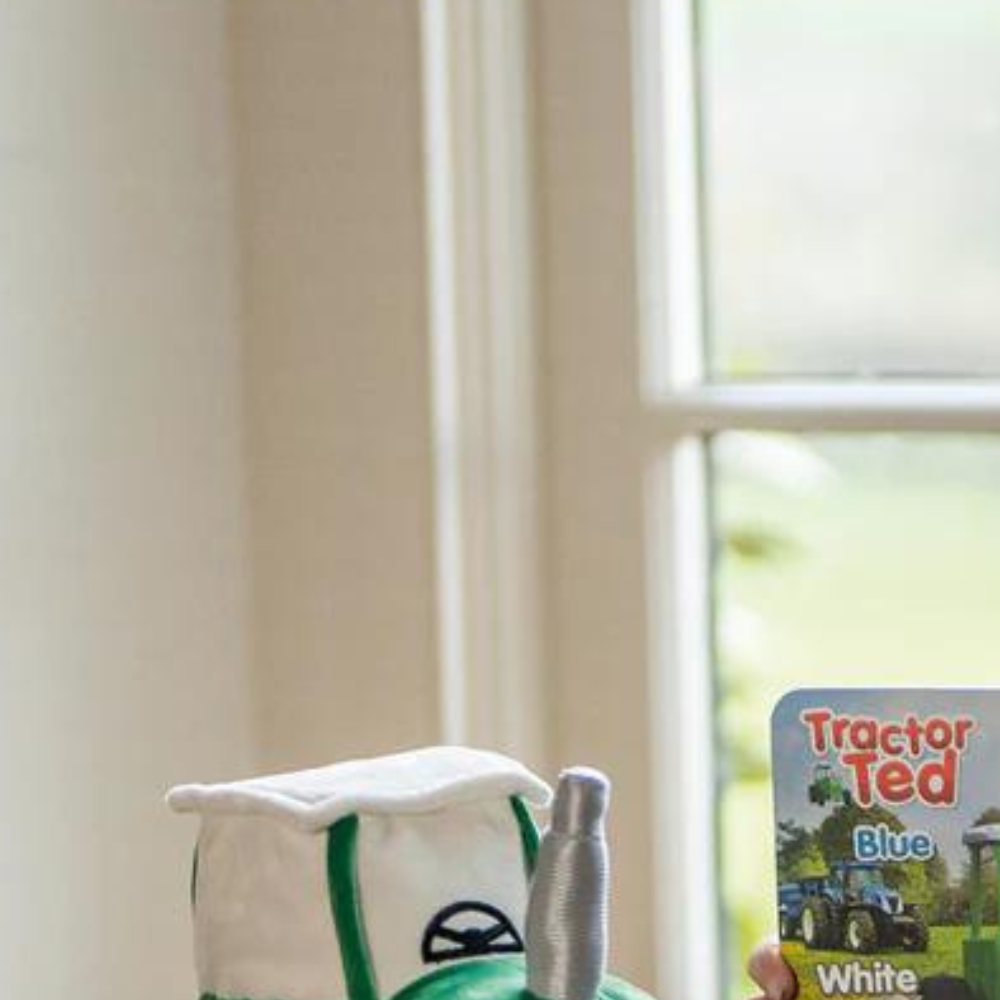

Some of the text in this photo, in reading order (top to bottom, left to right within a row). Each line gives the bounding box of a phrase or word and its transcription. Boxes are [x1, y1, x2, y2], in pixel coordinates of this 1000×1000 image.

[804, 708, 974, 757] Tractor
[841, 747, 957, 808] Ted
[854, 828, 934, 861] Blue
[817, 963, 919, 996] White
